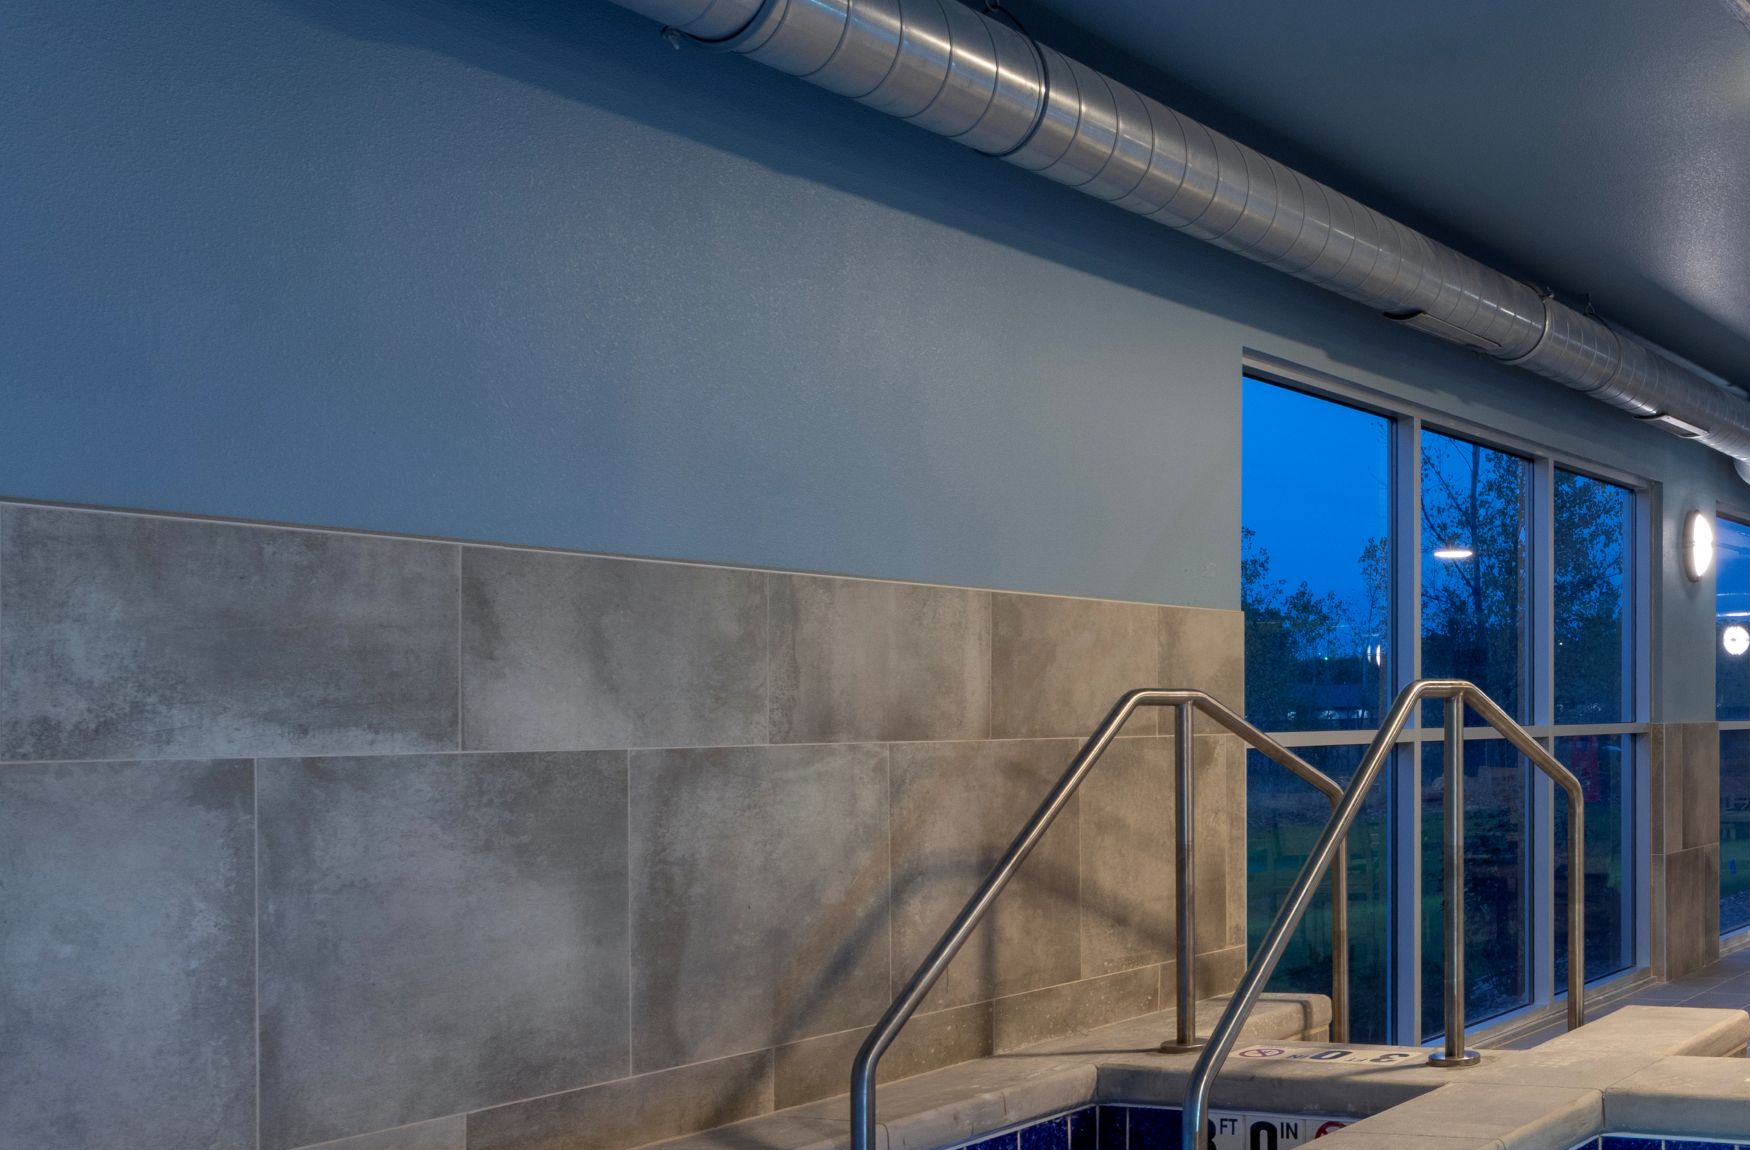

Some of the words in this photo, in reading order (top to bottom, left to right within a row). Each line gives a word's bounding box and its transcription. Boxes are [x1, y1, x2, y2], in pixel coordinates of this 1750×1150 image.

[1369, 1053, 1410, 1062] 3
[1219, 1118, 1238, 1135] FT
[1280, 1122, 1298, 1139] IN
